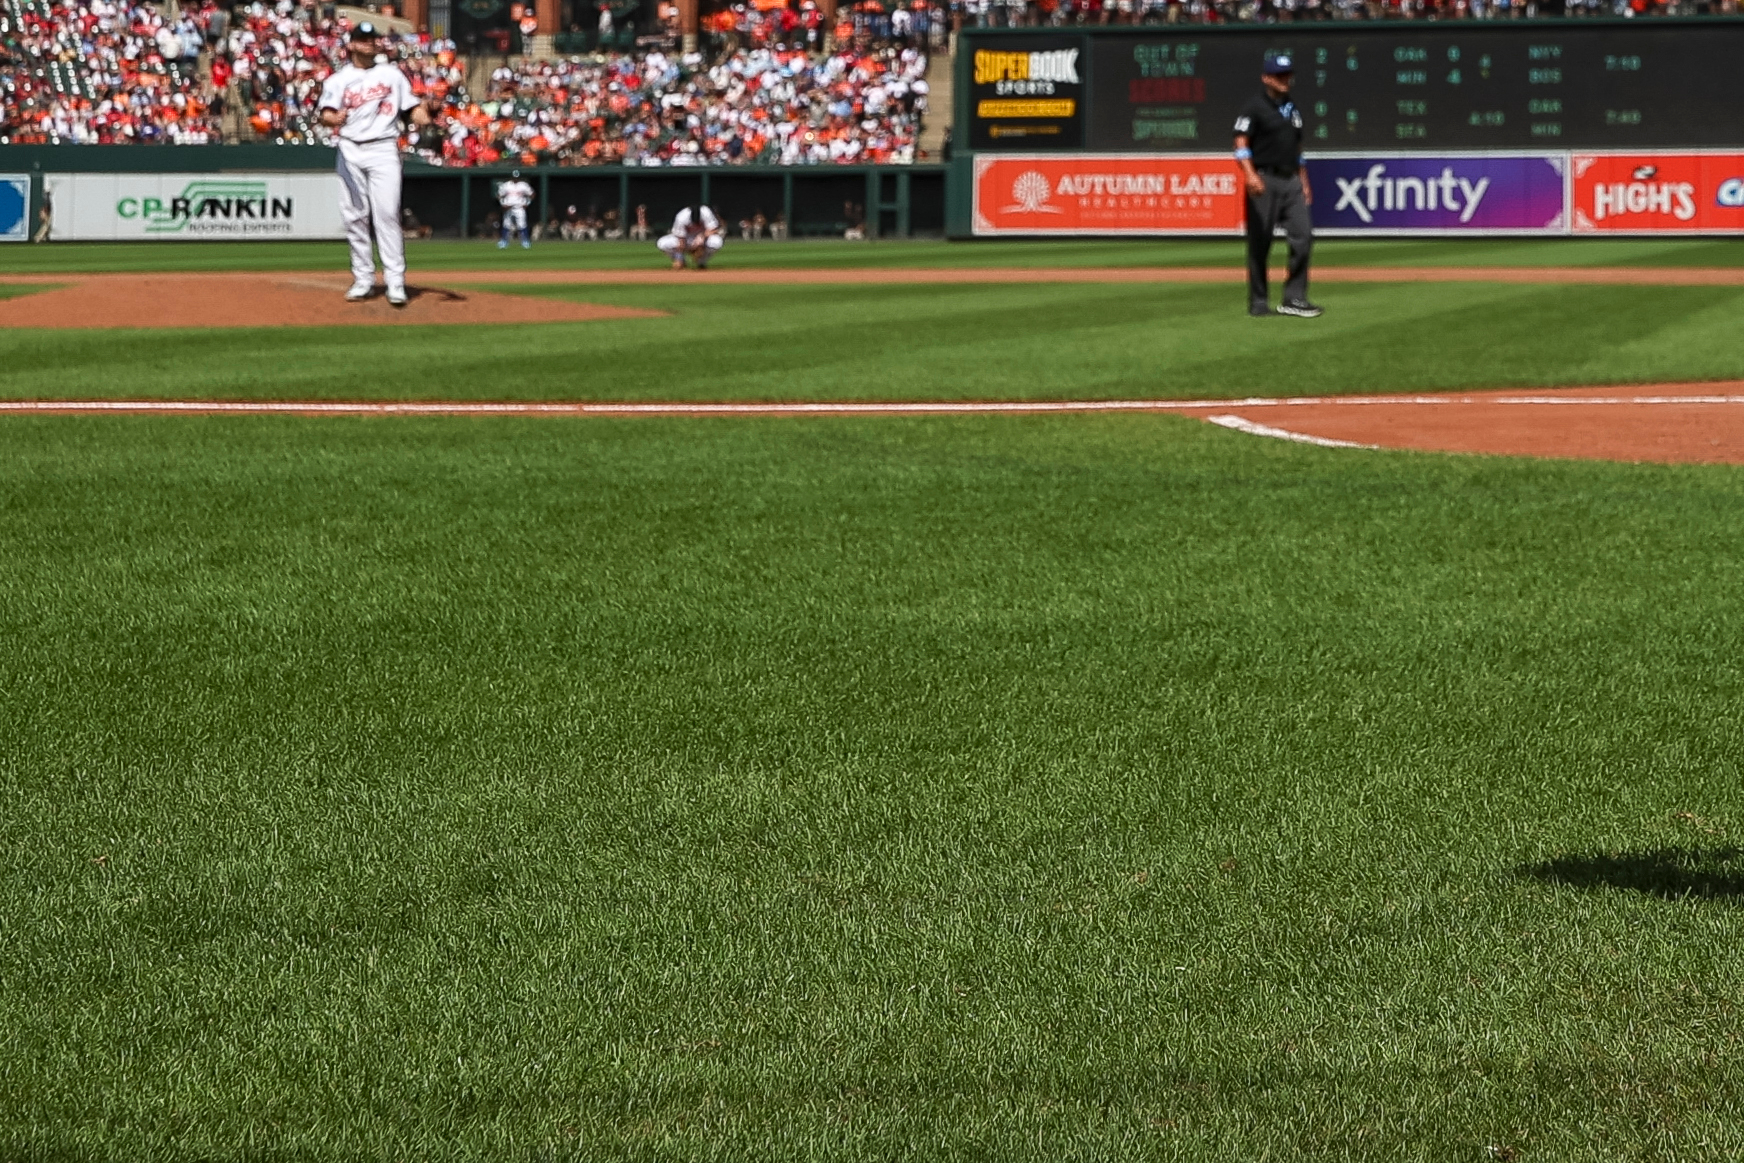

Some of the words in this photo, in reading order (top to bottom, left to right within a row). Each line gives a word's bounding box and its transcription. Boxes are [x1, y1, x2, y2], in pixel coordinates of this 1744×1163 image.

[975, 48, 1080, 85] SUPERBOOK
[996, 80, 1055, 95] SPORTS
[1057, 174, 1165, 196] AUTUMN
[1170, 174, 1238, 196] LAKE
[1334, 163, 1490, 223] xfinity
[117, 198, 162, 219] CP
[171, 197, 293, 220] RANKIN
[1594, 182, 1696, 221] HIGH'S
